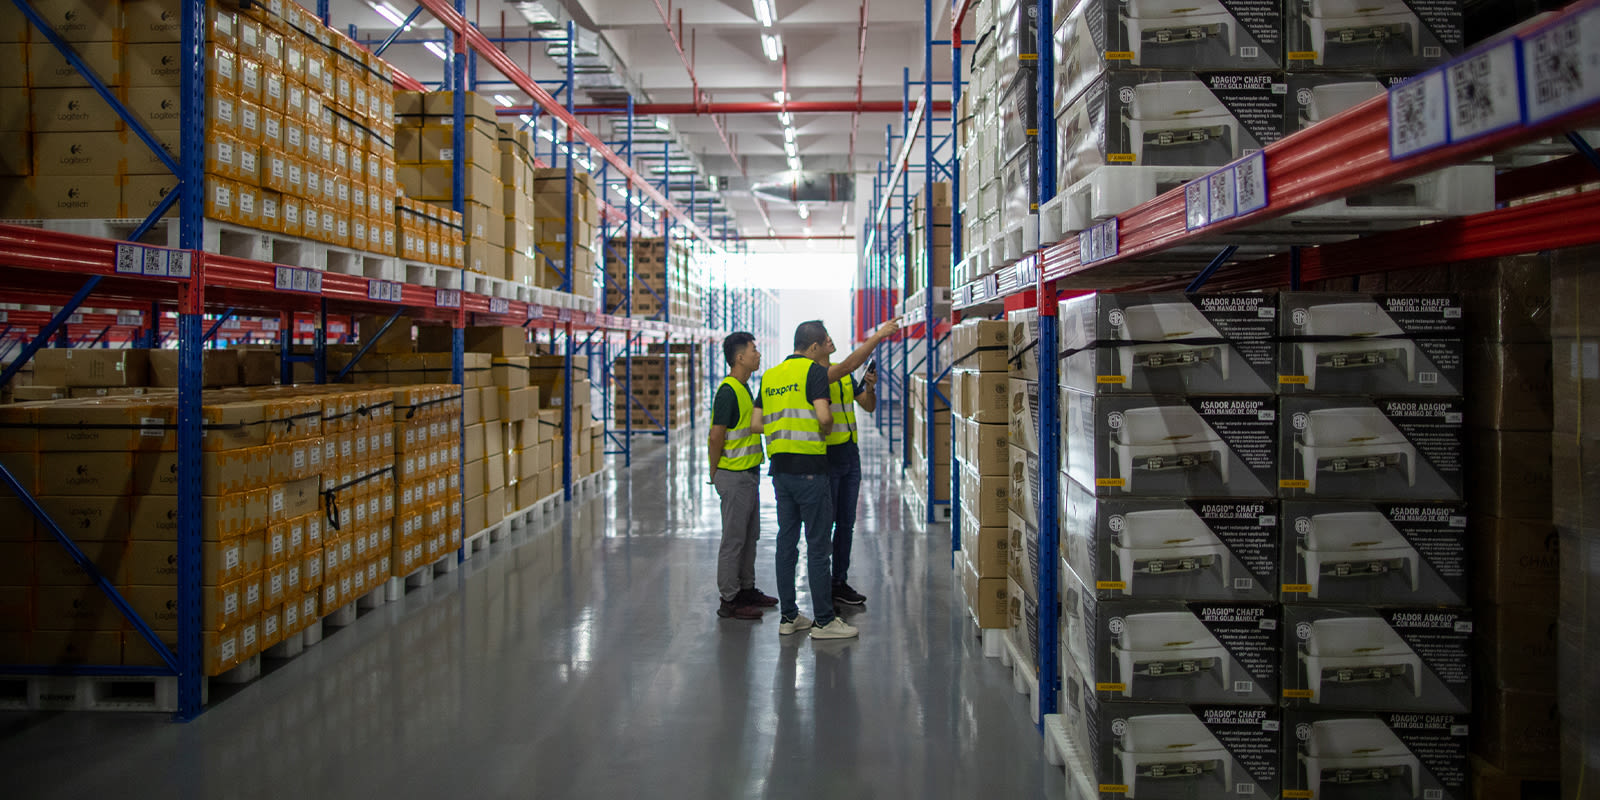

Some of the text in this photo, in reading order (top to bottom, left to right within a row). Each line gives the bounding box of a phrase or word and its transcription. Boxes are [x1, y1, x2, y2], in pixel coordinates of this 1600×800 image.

[55, 23, 87, 33] Logitech
[1243, 76, 1272, 84] CHAFER
[57, 112, 89, 121] Logitech
[60, 155, 92, 165] Logitech
[57, 199, 89, 209] Logitech
[1200, 298, 1229, 306] ASADOR
[1420, 298, 1450, 307] CHAFER
[1200, 401, 1229, 409] ASADOR
[1387, 403, 1417, 411] ASADOR
[66, 432, 99, 441] Logitech
[1235, 504, 1265, 513] CHAFER
[1390, 507, 1420, 515] ASADOR
[1235, 608, 1265, 616] CHAFER
[1391, 613, 1422, 621] ASADOR
[1237, 710, 1267, 718] CHAFER
[1425, 715, 1455, 724] CHAFER
